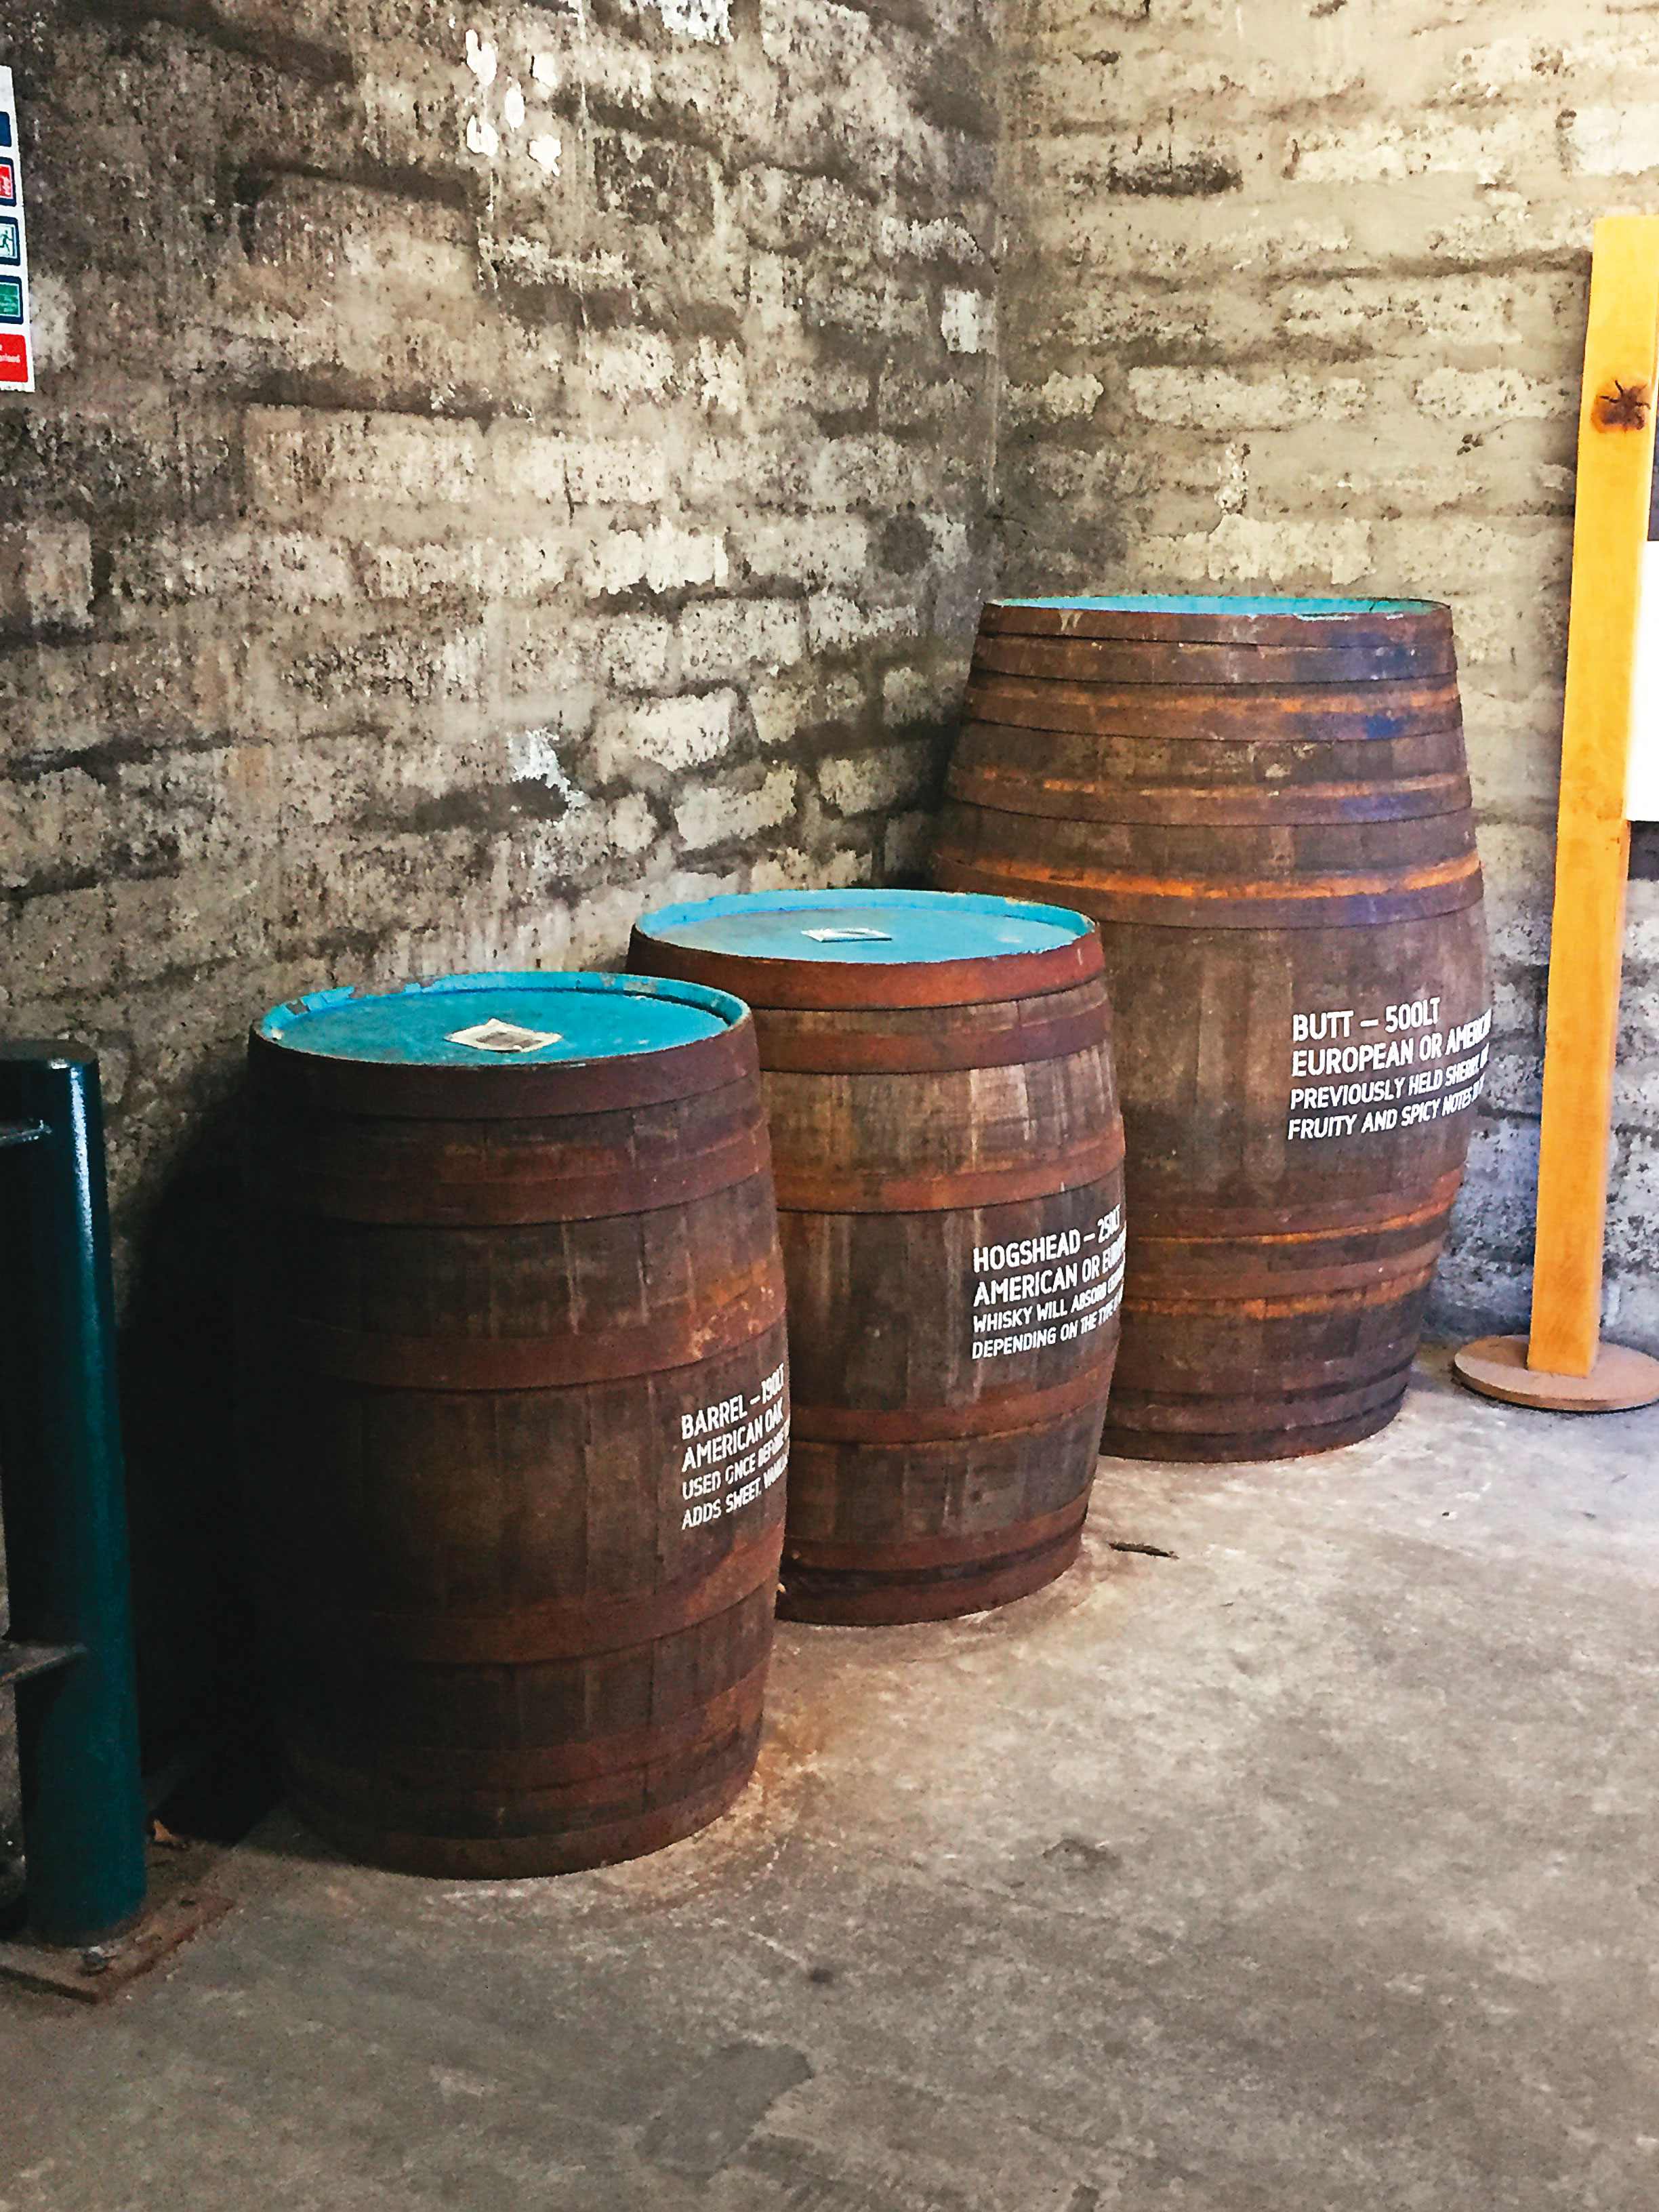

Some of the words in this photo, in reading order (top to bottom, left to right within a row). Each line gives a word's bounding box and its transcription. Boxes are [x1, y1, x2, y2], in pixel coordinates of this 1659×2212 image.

[1291, 1038, 1414, 1077] EUROPEAN
[1419, 1032, 1443, 1061] OR
[1445, 1008, 1492, 1055] AMERIC
[1292, 1010, 1354, 1042] BUTT
[1385, 997, 1440, 1033] 500LT
[1290, 1077, 1406, 1109] PREVIOUSLY
[1408, 1069, 1443, 1096] HELD
[1288, 1113, 1357, 1140] FRUITY
[1361, 1108, 1398, 1133] AND
[1401, 1098, 1441, 1126] SPICY
[1441, 1086, 1473, 1116] NOTES
[972, 1228, 1080, 1273] HOGSHEAD
[973, 1263, 1077, 1307] AMERICAN
[1082, 1254, 1100, 1282] OR
[972, 1326, 1057, 1359] DEPENDING
[1060, 1319, 1079, 1340] ON
[1080, 1311, 1097, 1334] THE
[973, 1305, 1033, 1333] WHISKY
[1036, 1298, 1067, 1322] WILL
[681, 1394, 747, 1440] BARREL
[681, 1415, 763, 1472] AMERICAN
[765, 1397, 784, 1433] OAK
[682, 1471, 721, 1500] USED
[725, 1452, 756, 1484] ONCE
[681, 1498, 722, 1530] ADDS
